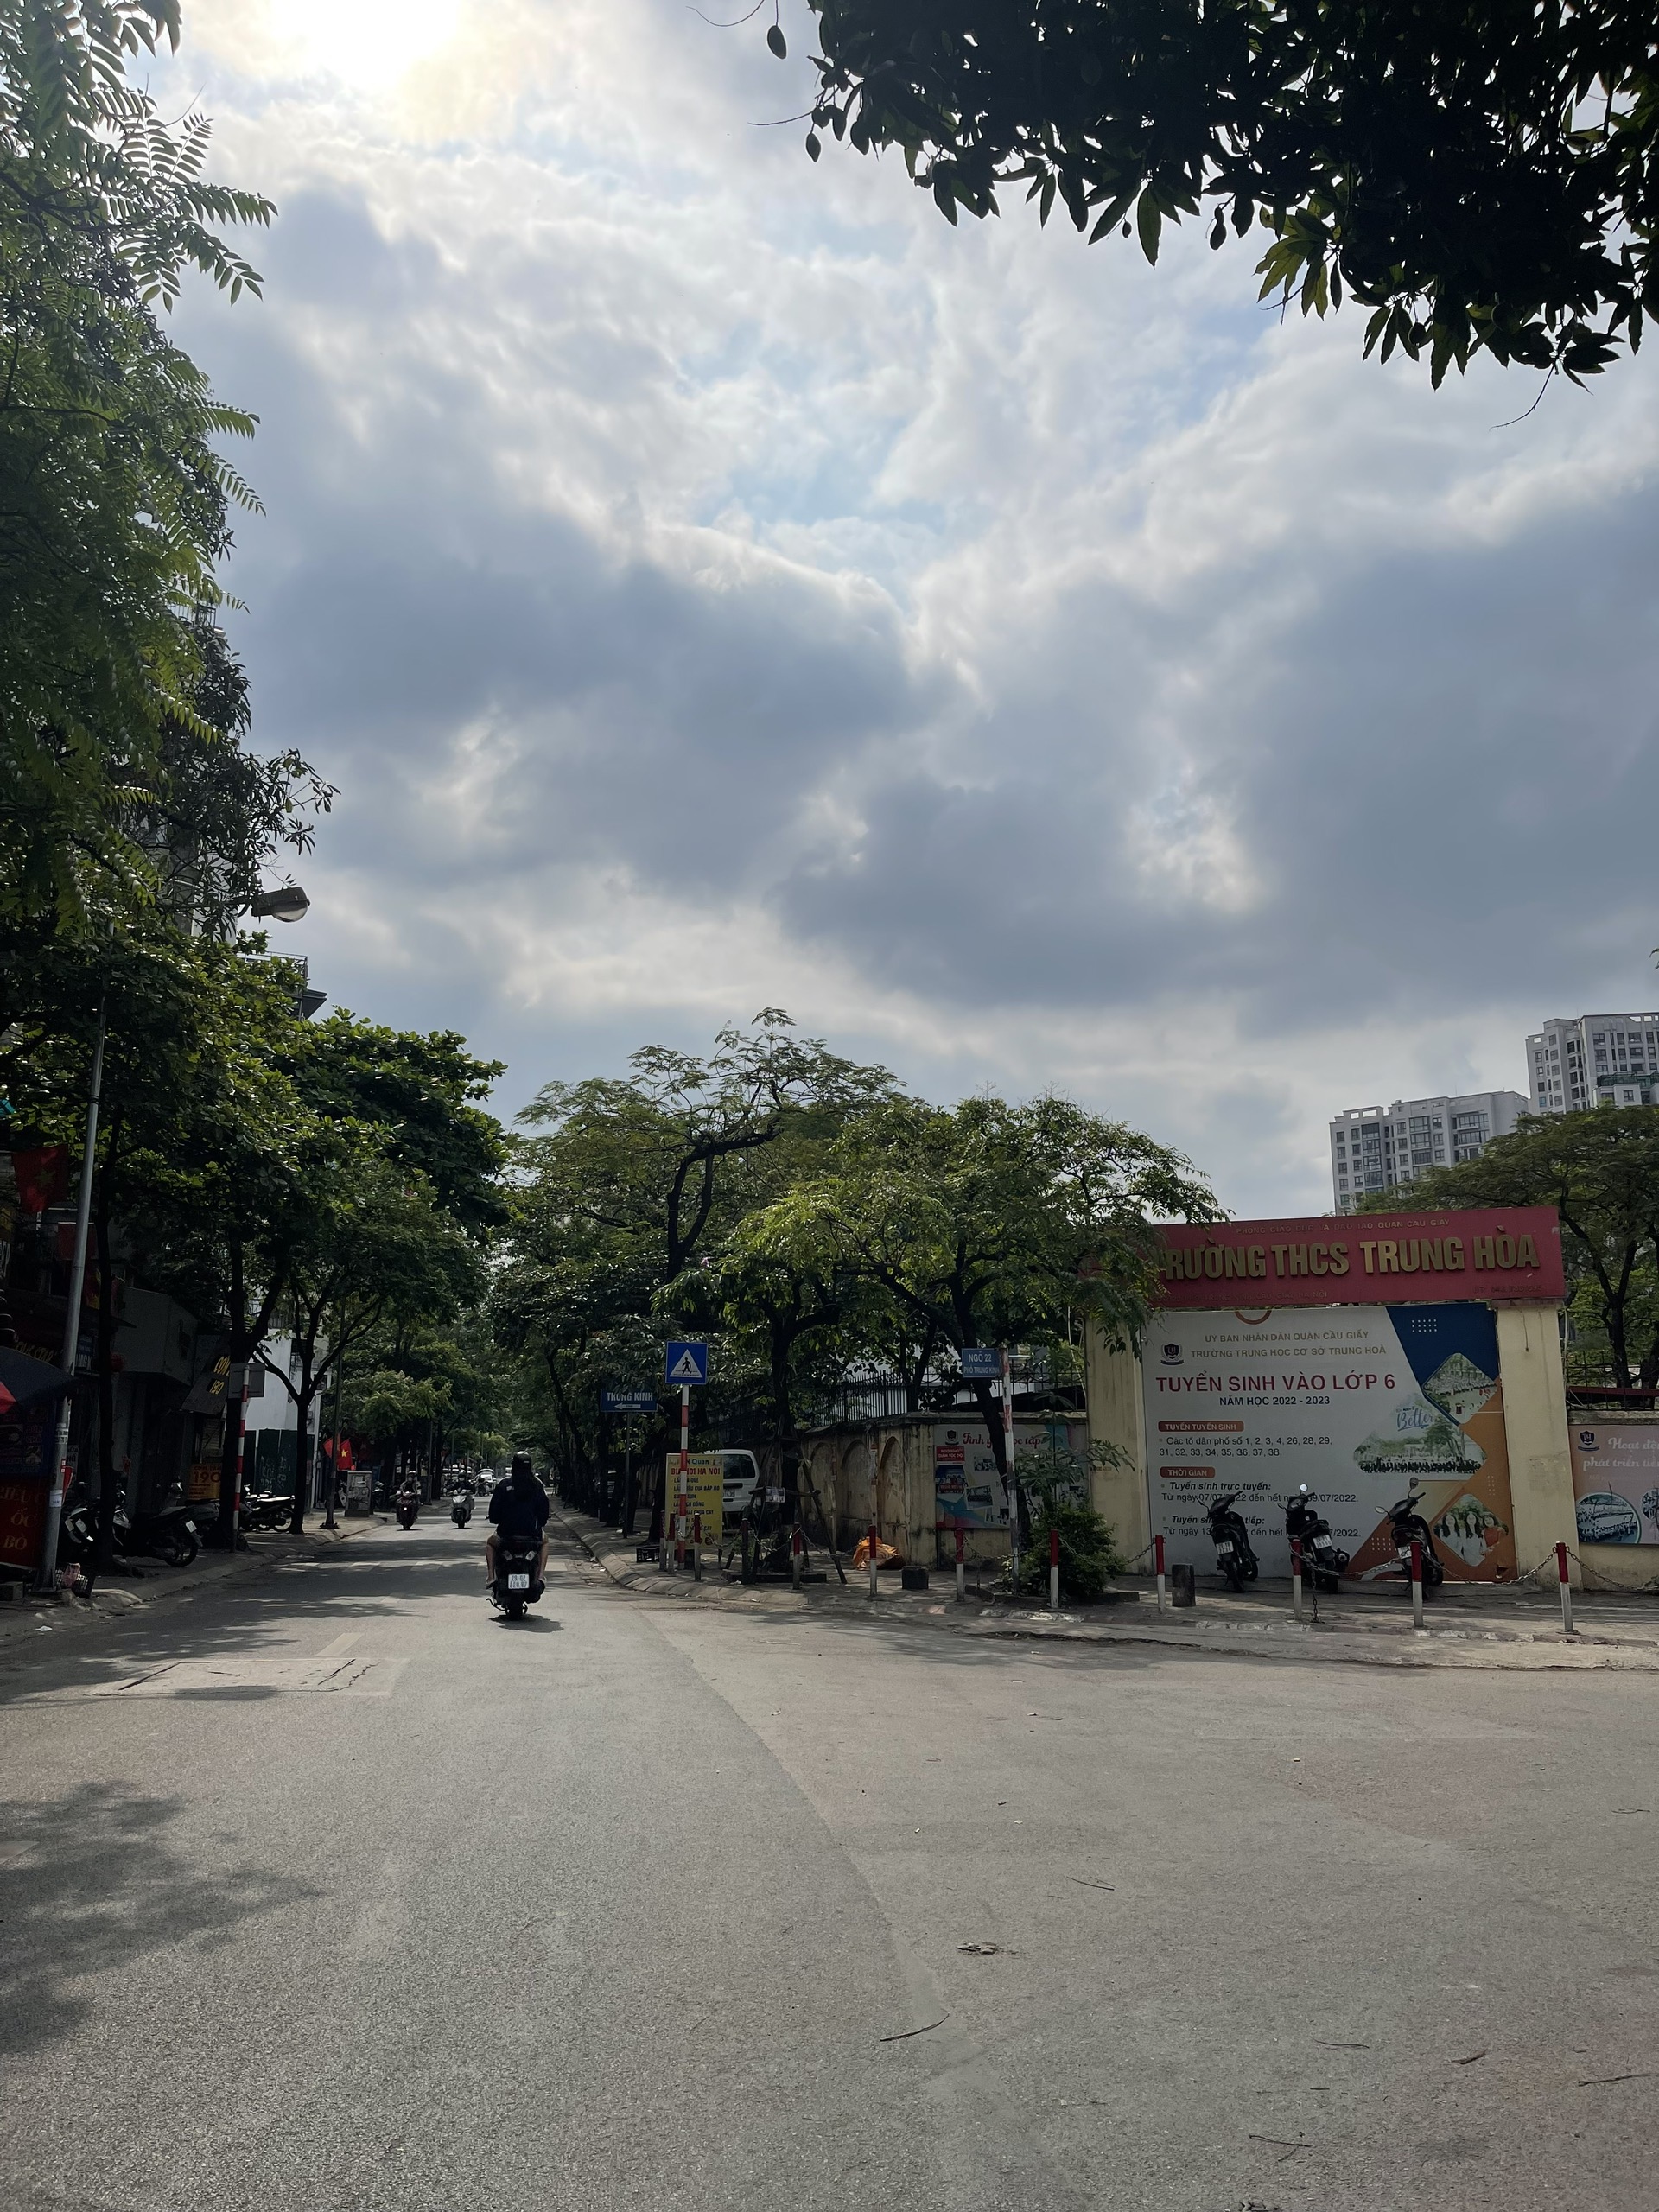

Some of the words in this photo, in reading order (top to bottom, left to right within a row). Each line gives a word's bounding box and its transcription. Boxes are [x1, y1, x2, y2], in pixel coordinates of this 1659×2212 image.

[1163, 1238, 1268, 1280] RƯỜNG
[1271, 1243, 1350, 1278] THCS
[1359, 1236, 1465, 1274] TRUNG
[1472, 1225, 1541, 1270] HÒA
[1243, 1332, 1268, 1342] NHÂN
[1271, 1332, 1290, 1341] DÂN
[1323, 1331, 1343, 1340] CẦU
[1346, 1329, 1369, 1339] GIẤY
[969, 1351, 983, 1363] NGÕ
[984, 1353, 992, 1363] 22
[1191, 1348, 1232, 1358] TRƯỜNG
[1236, 1349, 1268, 1357] TRUNG
[1270, 1349, 1291, 1359] HỌC
[1329, 1346, 1363, 1356] TRUNG
[1156, 1370, 1222, 1392] TUYỂN
[1228, 1376, 1275, 1392] SINH
[1282, 1371, 1325, 1391] VÀO
[1332, 1370, 1377, 1390] LỚP
[1384, 1374, 1395, 1389] 6
[1219, 1395, 1243, 1406] NĂM
[1247, 1396, 1269, 1407] HỌC
[1273, 1396, 1296, 1405] 2022
[1306, 1395, 1330, 1405] 2023
[1396, 1408, 1433, 1432] Better
[963, 1433, 985, 1445] Tình
[1214, 1436, 1230, 1446] phố
[1232, 1436, 1243, 1445] số
[1265, 1437, 1274, 1446] 3,
[1276, 1437, 1285, 1446] 4,
[1287, 1437, 1300, 1446] 26,
[1303, 1436, 1317, 1446] 28,
[1608, 1437, 1640, 1452] Hoạt
[1160, 1448, 1173, 1457] 31,
[1175, 1448, 1188, 1457] 32,
[1191, 1448, 1204, 1457] 33,
[1205, 1448, 1219, 1457] 34,
[1221, 1448, 1235, 1457] 35,
[1236, 1448, 1250, 1457] 36,
[1253, 1448, 1266, 1457] 37,
[1583, 1455, 1611, 1471] phát
[1612, 1455, 1640, 1468] triển
[1198, 1482, 1218, 1491] sinh
[1221, 1483, 1240, 1491] trực
[1176, 1493, 1196, 1503] ngày
[1267, 1493, 1281, 1502] hết
[1245, 1516, 1265, 1525] tiếp:
[1179, 1528, 1198, 1537] ngày
[1250, 1528, 1267, 1536] đến
[1269, 1528, 1284, 1536] hết
